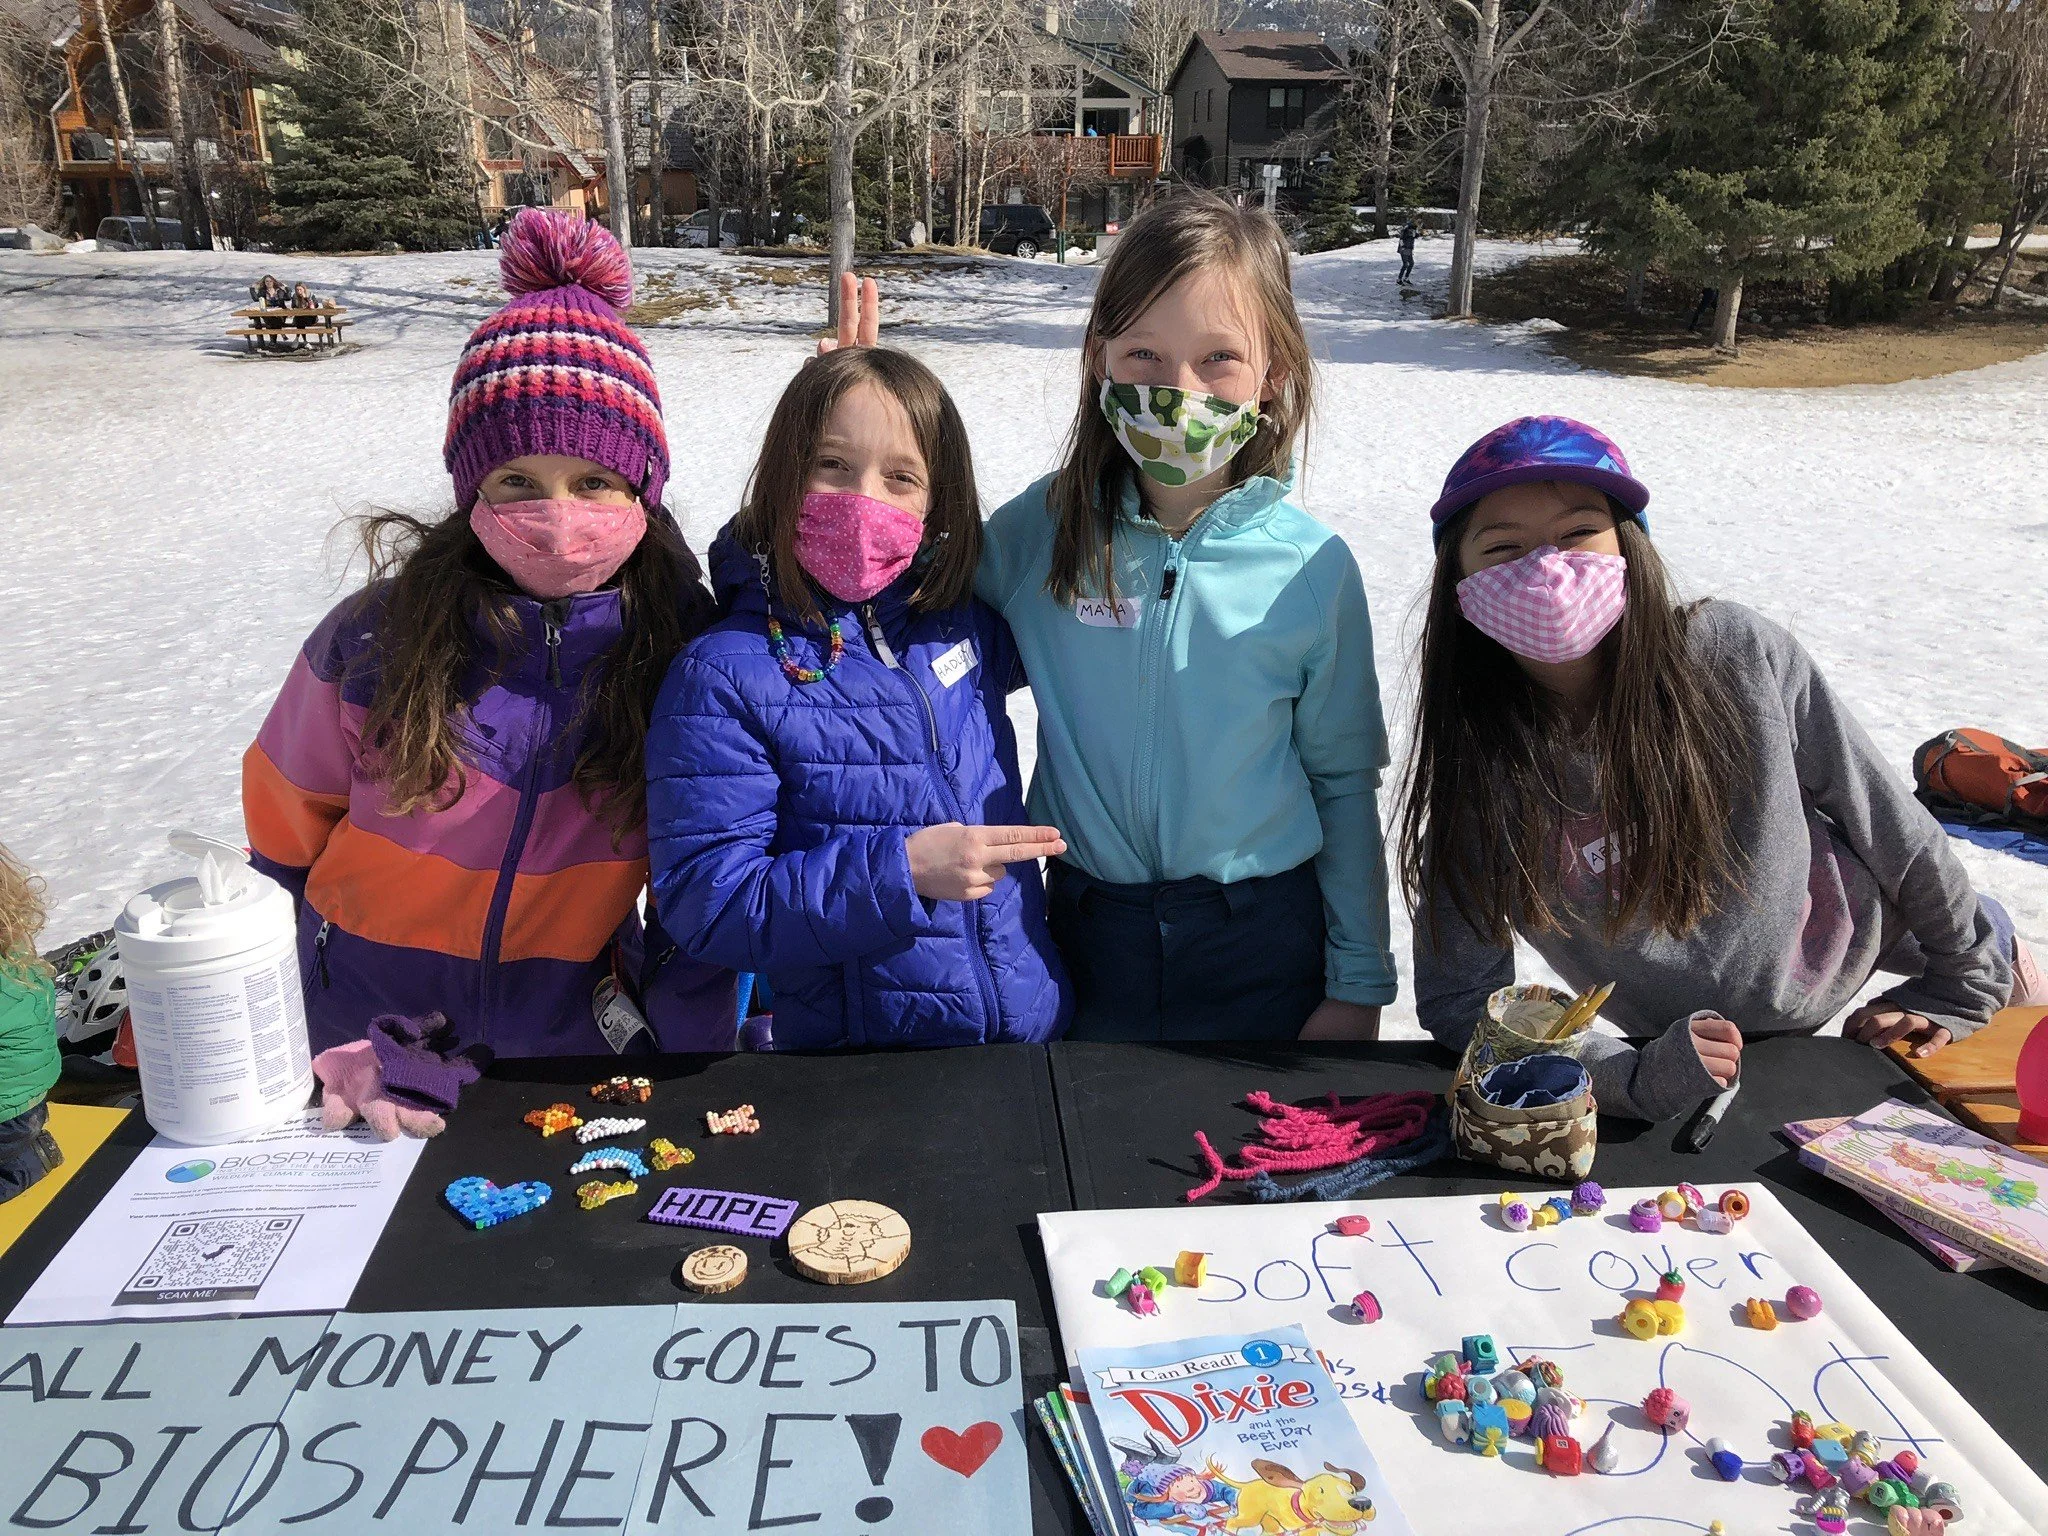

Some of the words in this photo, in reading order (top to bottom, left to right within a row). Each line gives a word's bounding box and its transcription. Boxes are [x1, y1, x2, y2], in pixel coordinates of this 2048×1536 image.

[1080, 603, 1126, 619] MAYA
[220, 1150, 384, 1169] BIOSPHERE
[310, 1169, 373, 1177] COMMUNITY
[657, 1191, 789, 1231] HOPE
[1981, 1241, 2009, 1261] Secret
[2009, 1256, 2042, 1276] Admirer
[157, 1290, 190, 1300] SCAN
[192, 1289, 218, 1298] ME!
[0, 1340, 152, 1404] ALL
[228, 1322, 583, 1398] MONEY
[652, 1324, 878, 1389] GOES
[898, 1315, 1013, 1393] TO
[1255, 1346, 1269, 1360] 1
[1127, 1370, 1135, 1381] I
[1140, 1369, 1180, 1382] Can
[1185, 1354, 1239, 1376] Read!
[1106, 1373, 1319, 1448] Dixie
[1249, 1419, 1272, 1430] and
[1275, 1416, 1297, 1428] the
[1237, 1429, 1277, 1444] Best
[1260, 1438, 1299, 1453] Ever
[9, 1412, 903, 1535] BIOSPHERE!
